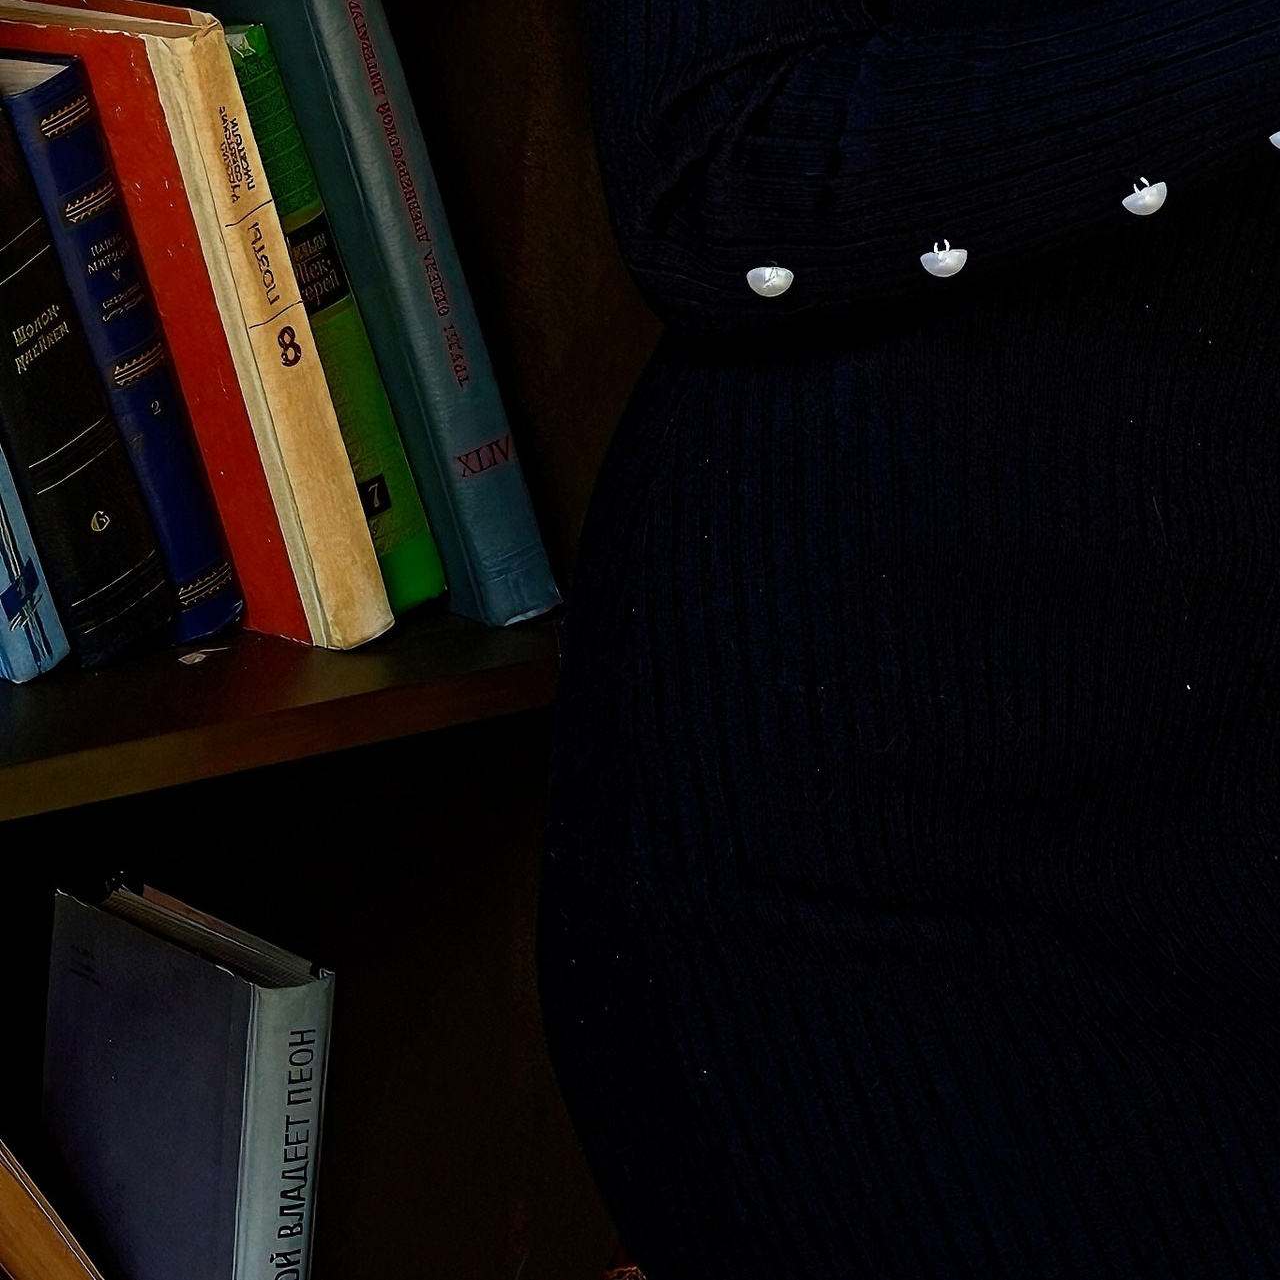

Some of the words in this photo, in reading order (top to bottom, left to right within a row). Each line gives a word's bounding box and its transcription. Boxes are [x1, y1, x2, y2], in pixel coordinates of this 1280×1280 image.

[277, 325, 303, 369] 8
[452, 434, 511, 478] XLIV
[368, 483, 381, 508] 7
[286, 1028, 317, 1106] ПЕОН
[277, 1114, 311, 1240] ВЛАДЕЕТ
